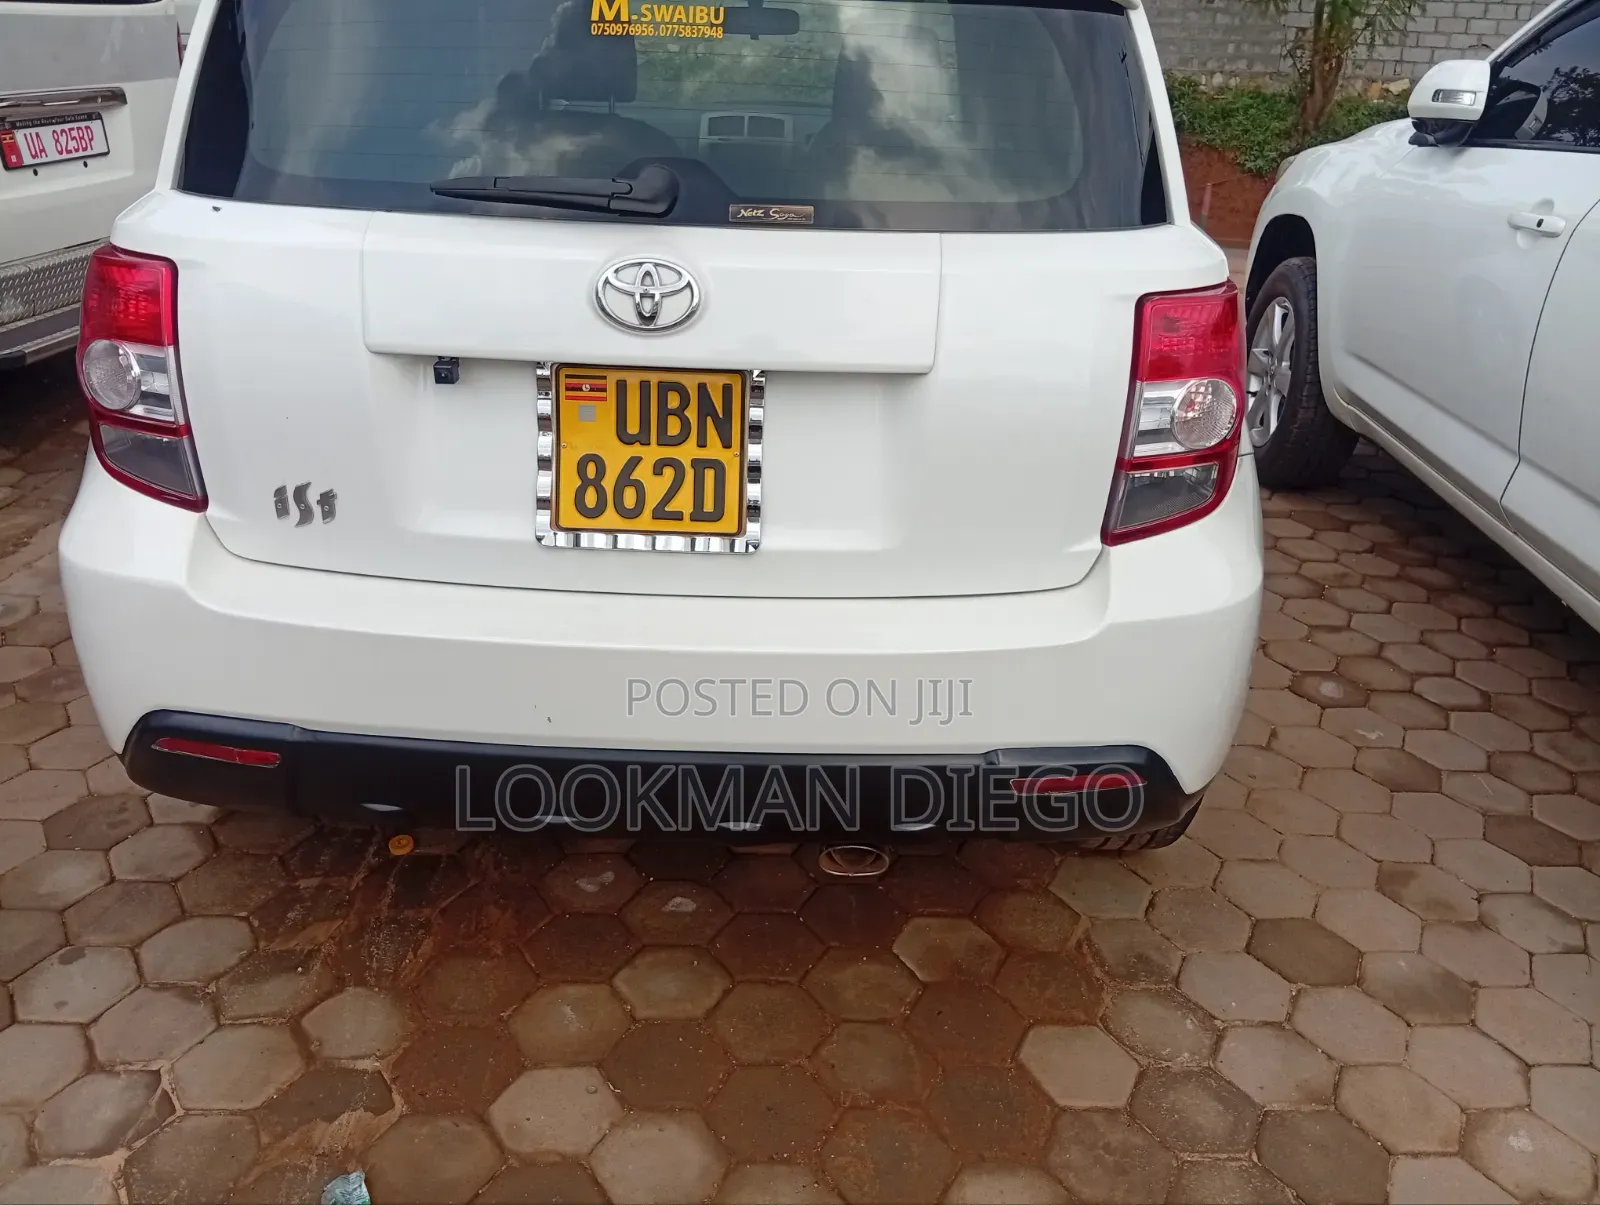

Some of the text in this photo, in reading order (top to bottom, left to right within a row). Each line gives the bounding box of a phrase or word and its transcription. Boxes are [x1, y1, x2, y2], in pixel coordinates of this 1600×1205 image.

[24, 125, 94, 159] UA 825BP
[616, 379, 733, 448] UBN
[574, 453, 727, 522] 862D
